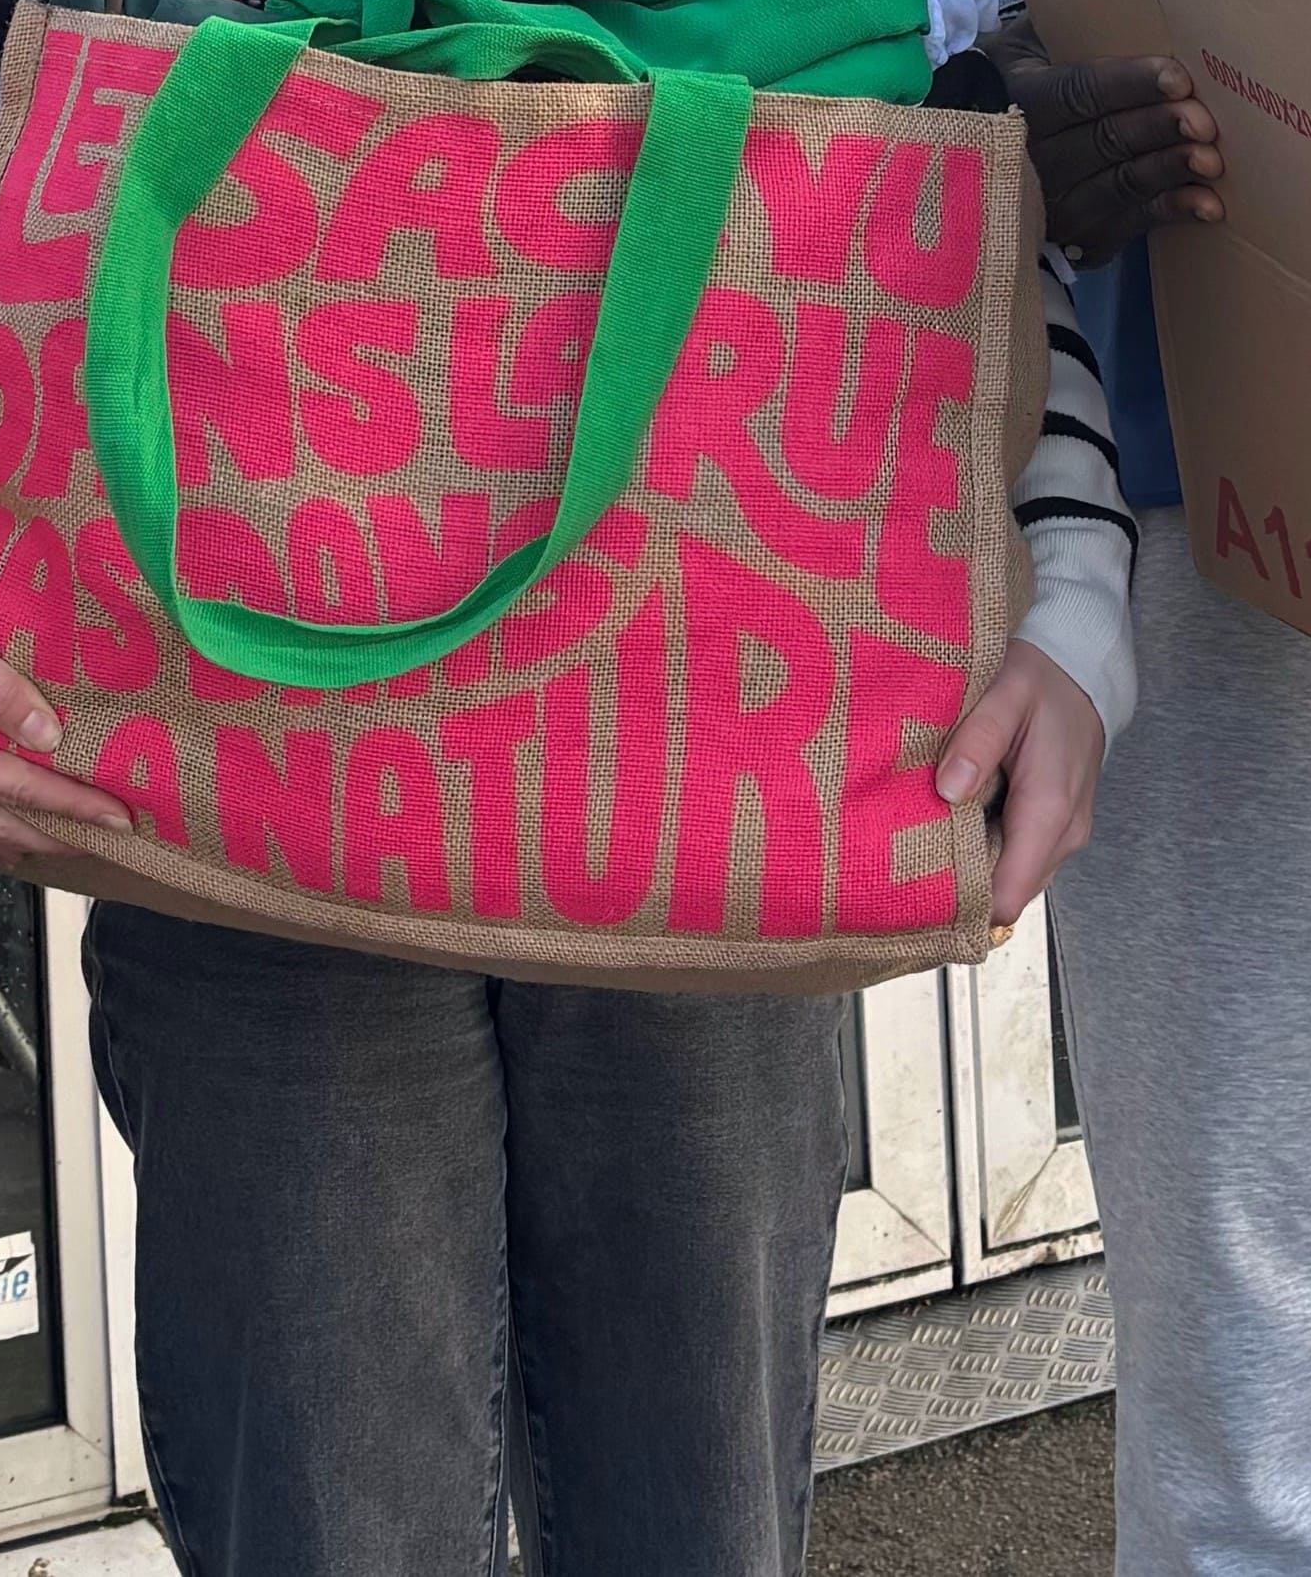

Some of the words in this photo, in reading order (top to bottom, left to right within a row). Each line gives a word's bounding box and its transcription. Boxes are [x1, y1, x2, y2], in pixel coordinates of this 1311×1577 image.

[171, 73, 648, 289] SAC
[742, 126, 983, 310] VU
[645, 286, 975, 642] RUE
[216, 533, 966, 939] NATURE
